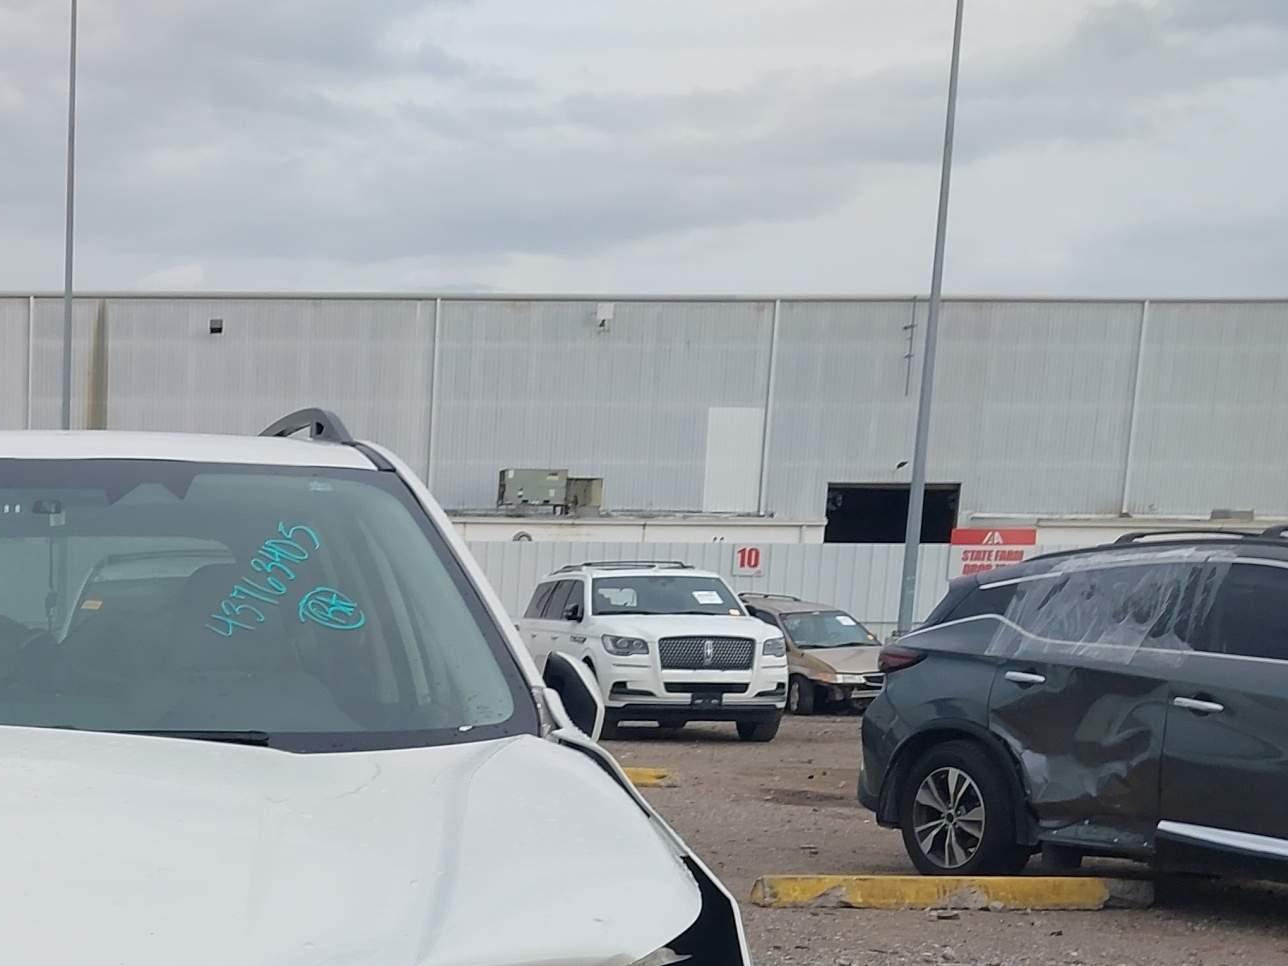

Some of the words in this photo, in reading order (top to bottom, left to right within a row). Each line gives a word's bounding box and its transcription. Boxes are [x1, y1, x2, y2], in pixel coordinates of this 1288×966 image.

[737, 547, 760, 569] 10
[961, 550, 994, 562] STATE
[994, 550, 1025, 562] FARM
[205, 521, 319, 637] 43763405
